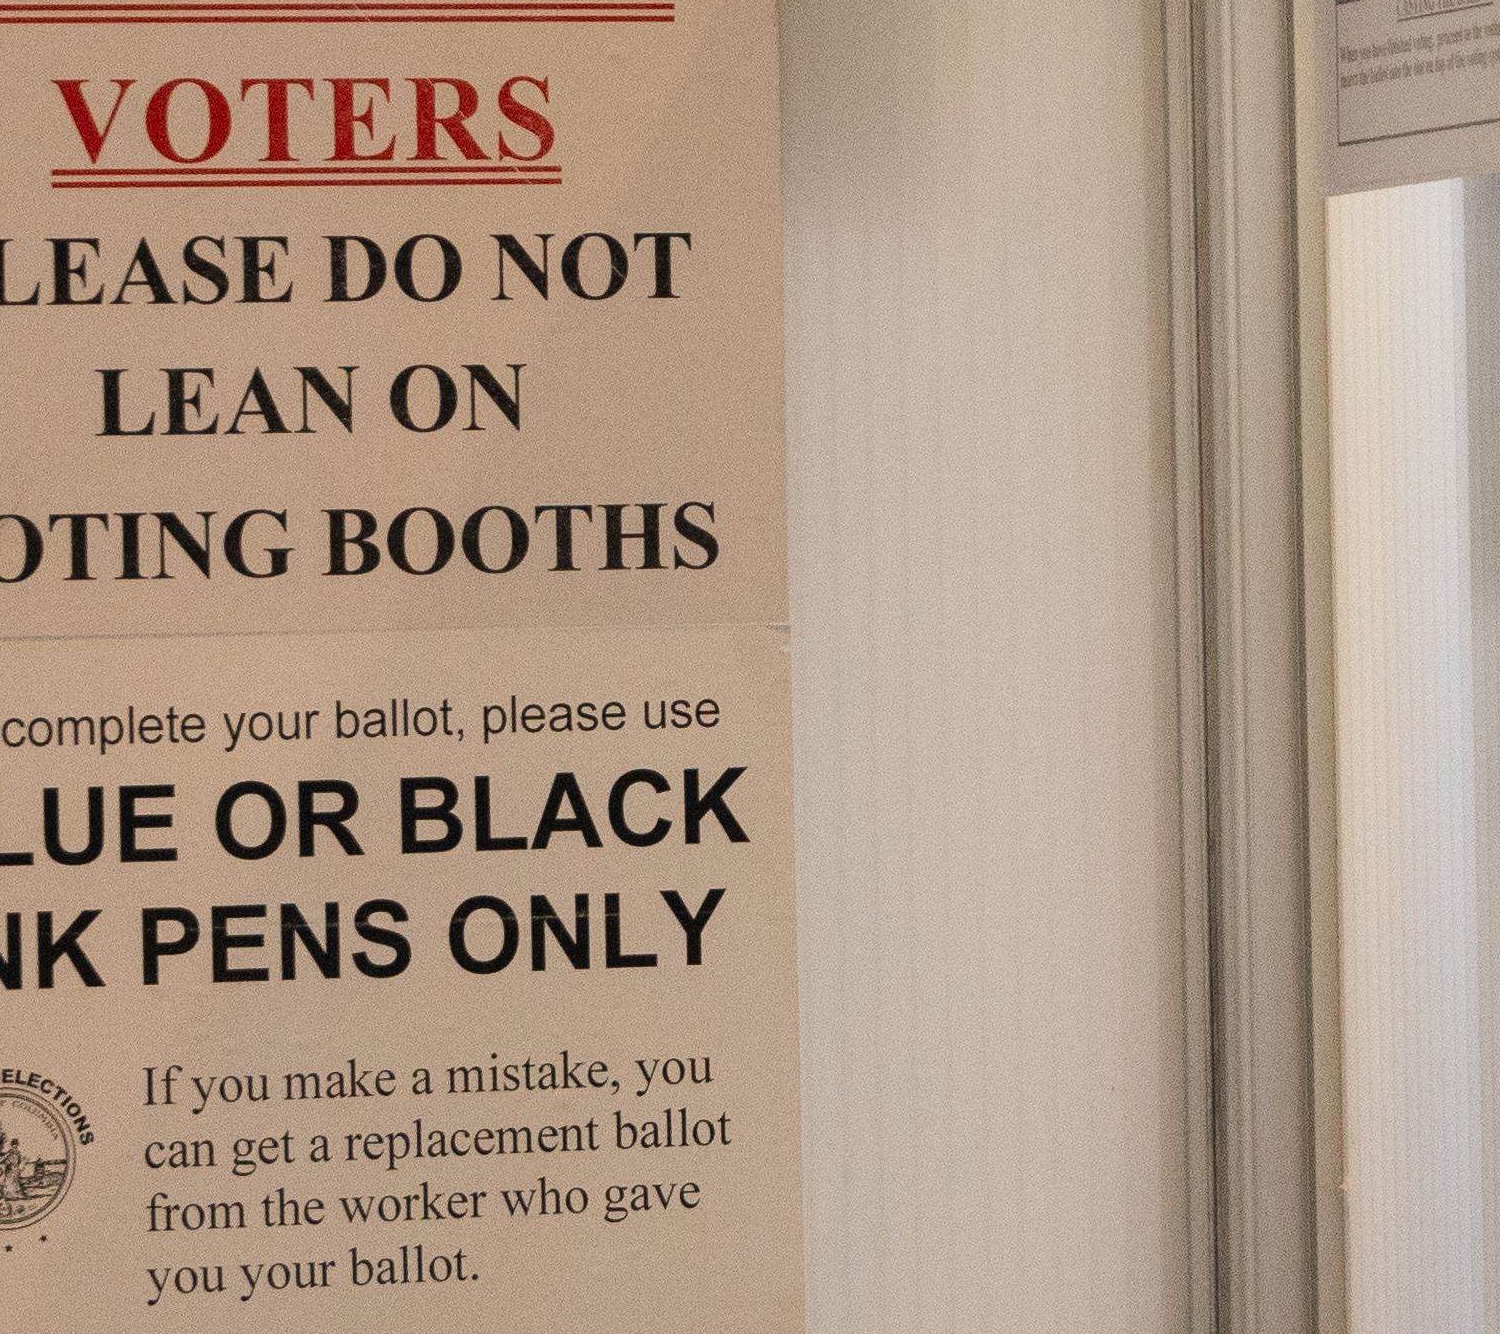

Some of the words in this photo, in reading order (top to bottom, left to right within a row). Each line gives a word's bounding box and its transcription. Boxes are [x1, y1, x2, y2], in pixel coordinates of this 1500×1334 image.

[52, 75, 555, 165] VOTERS
[325, 232, 463, 303] DO
[491, 231, 692, 301] NOT
[96, 364, 357, 437] LEAN
[387, 362, 522, 433] ON
[323, 501, 719, 576] BOOTHS
[0, 705, 206, 755] complete
[222, 708, 320, 753] your
[335, 697, 465, 742] ballot,
[482, 694, 627, 745] please
[643, 697, 721, 730] use
[213, 778, 364, 861] OR
[398, 766, 749, 855] BLACK
[140, 897, 412, 986] PENS
[447, 887, 725, 975] ONLY
[1, 1068, 95, 1146] ELECTIONS
[141, 1063, 183, 1107] If
[189, 1073, 270, 1116] you
[281, 1057, 396, 1101] make
[410, 1067, 434, 1096] a
[445, 1049, 620, 1095] mistake,
[633, 1056, 713, 1097] you
[143, 1138, 217, 1170] can
[230, 1129, 296, 1178] get
[308, 1133, 332, 1163] a
[343, 1117, 600, 1171] replacement
[612, 1106, 732, 1151] ballot
[145, 1191, 246, 1232] from
[259, 1185, 325, 1228] the
[337, 1180, 487, 1223] worker
[499, 1175, 589, 1217] who
[602, 1180, 700, 1224] gave
[145, 1264, 226, 1307] you
[238, 1259, 336, 1302] your
[347, 1243, 479, 1286] ballot.
